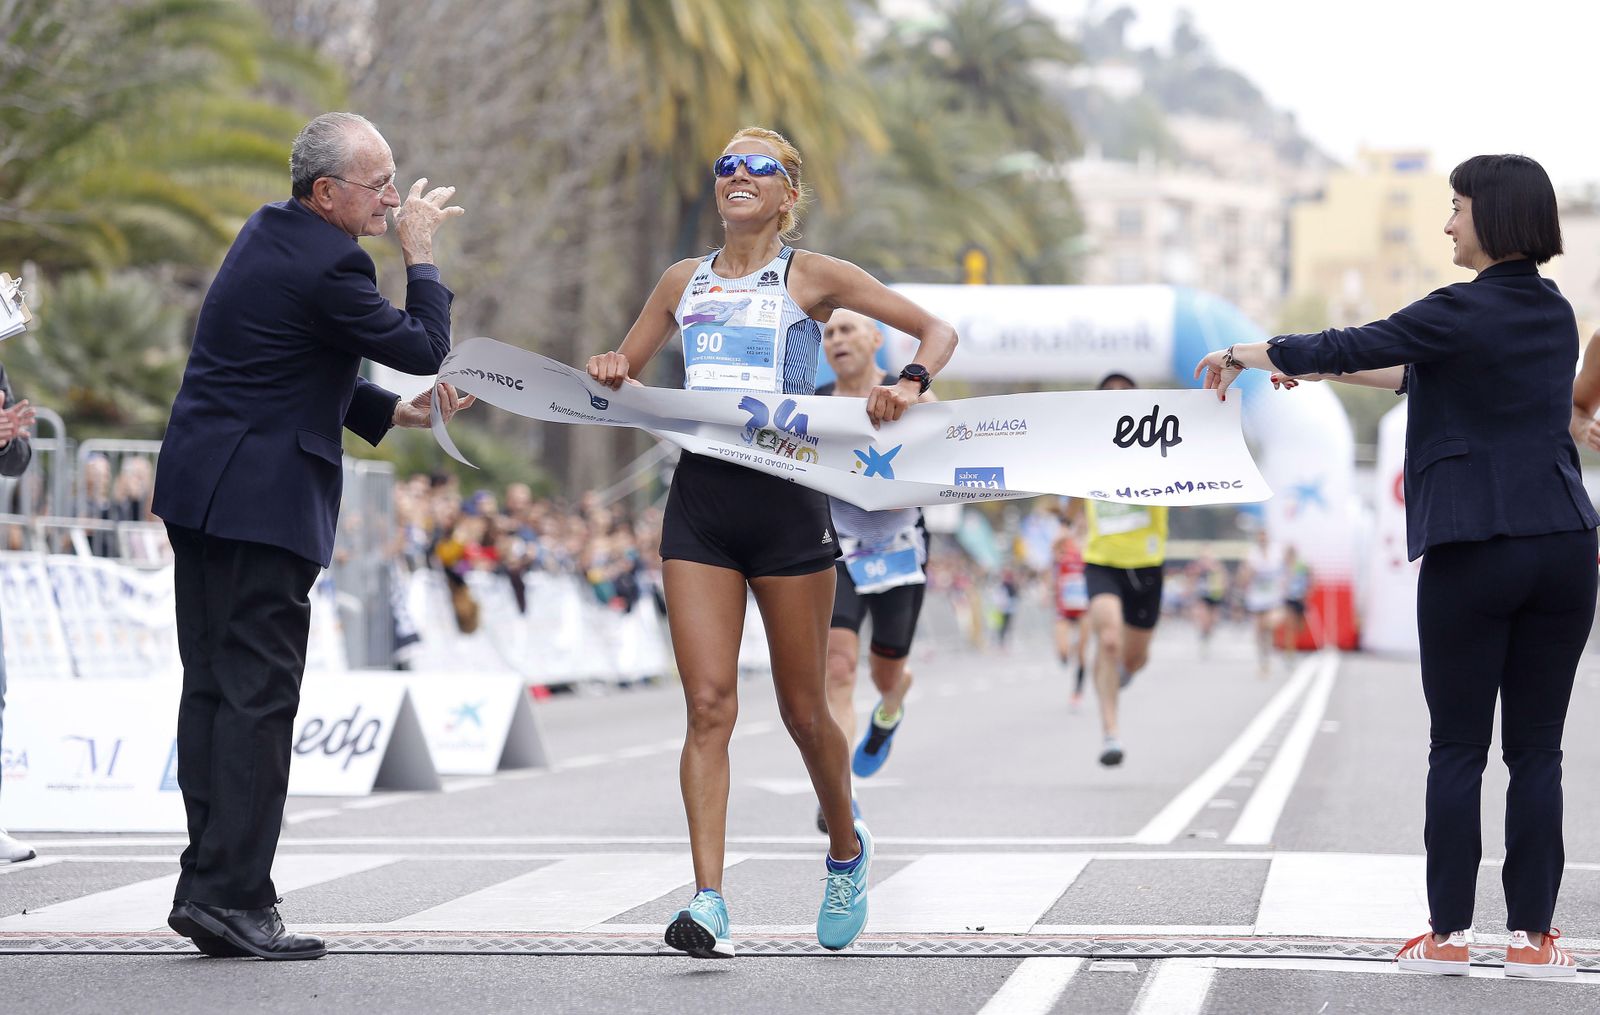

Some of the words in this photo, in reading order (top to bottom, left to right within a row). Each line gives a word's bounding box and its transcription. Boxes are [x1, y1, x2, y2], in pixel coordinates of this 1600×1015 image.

[696, 332, 723, 353] 90
[549, 401, 597, 421] Ayuntamiento
[976, 418, 1027, 431] MÁLAGA
[1113, 404, 1183, 457] edp
[719, 447, 752, 461] MÁLAGA
[753, 455, 763, 464] DE
[764, 458, 795, 471] CIUDAD
[959, 472, 979, 480] sabor
[293, 704, 381, 770] edp
